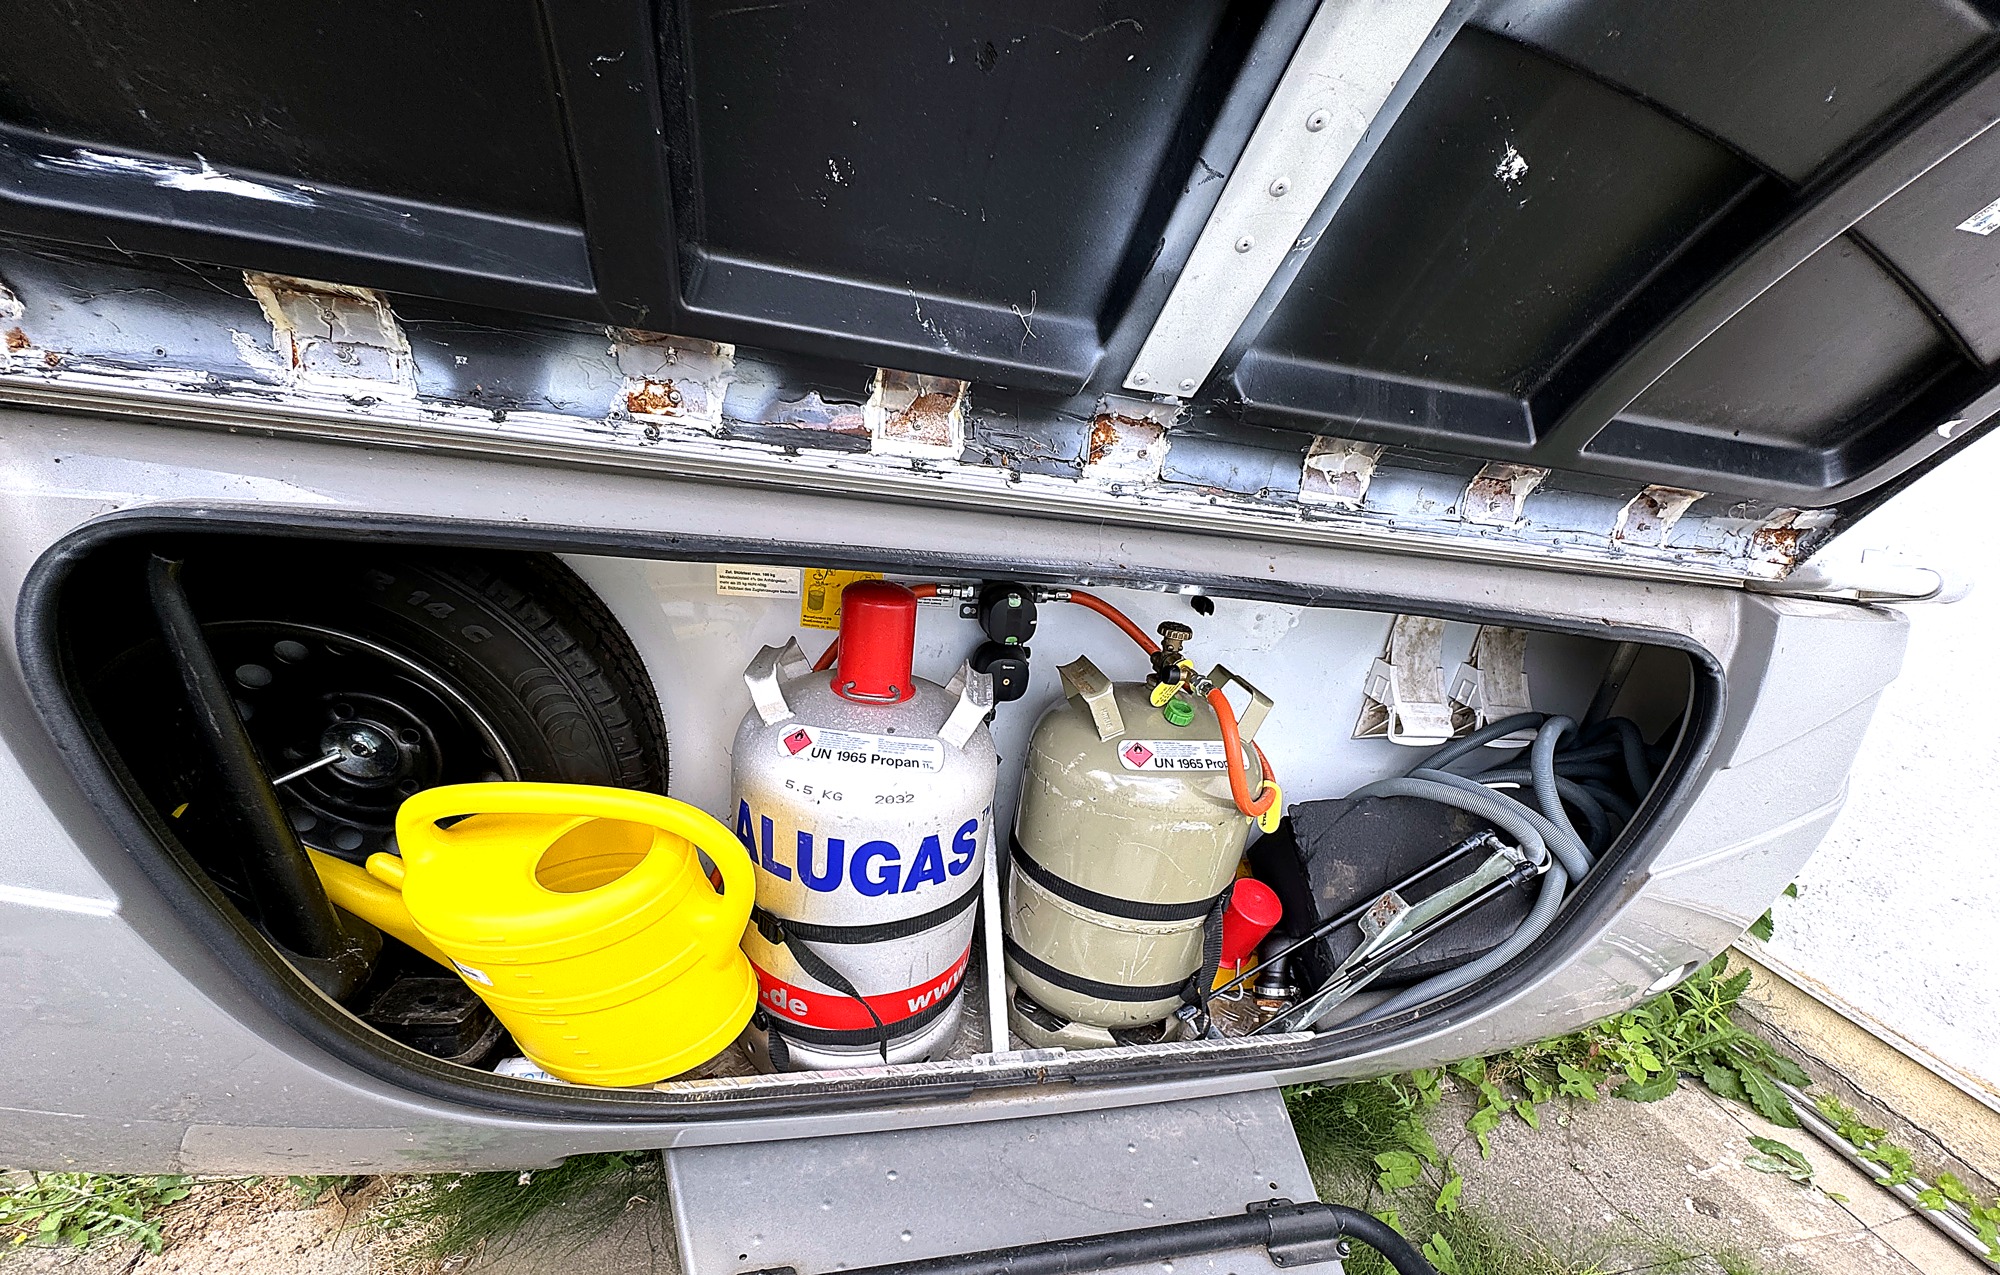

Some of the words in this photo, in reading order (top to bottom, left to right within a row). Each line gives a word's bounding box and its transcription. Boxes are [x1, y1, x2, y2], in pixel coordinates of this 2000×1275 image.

[811, 747, 832, 760] UN
[837, 751, 867, 764] 1965
[871, 754, 920, 769] Propan
[1154, 758, 1174, 769] UN
[1177, 759, 1204, 769] 1965
[1205, 759, 1228, 770] Prop
[785, 779, 814, 795] 5.5
[822, 789, 843, 802] KG
[874, 794, 915, 805] 2032
[736, 798, 978, 897] ALUGAS
[759, 986, 808, 1016] .de
